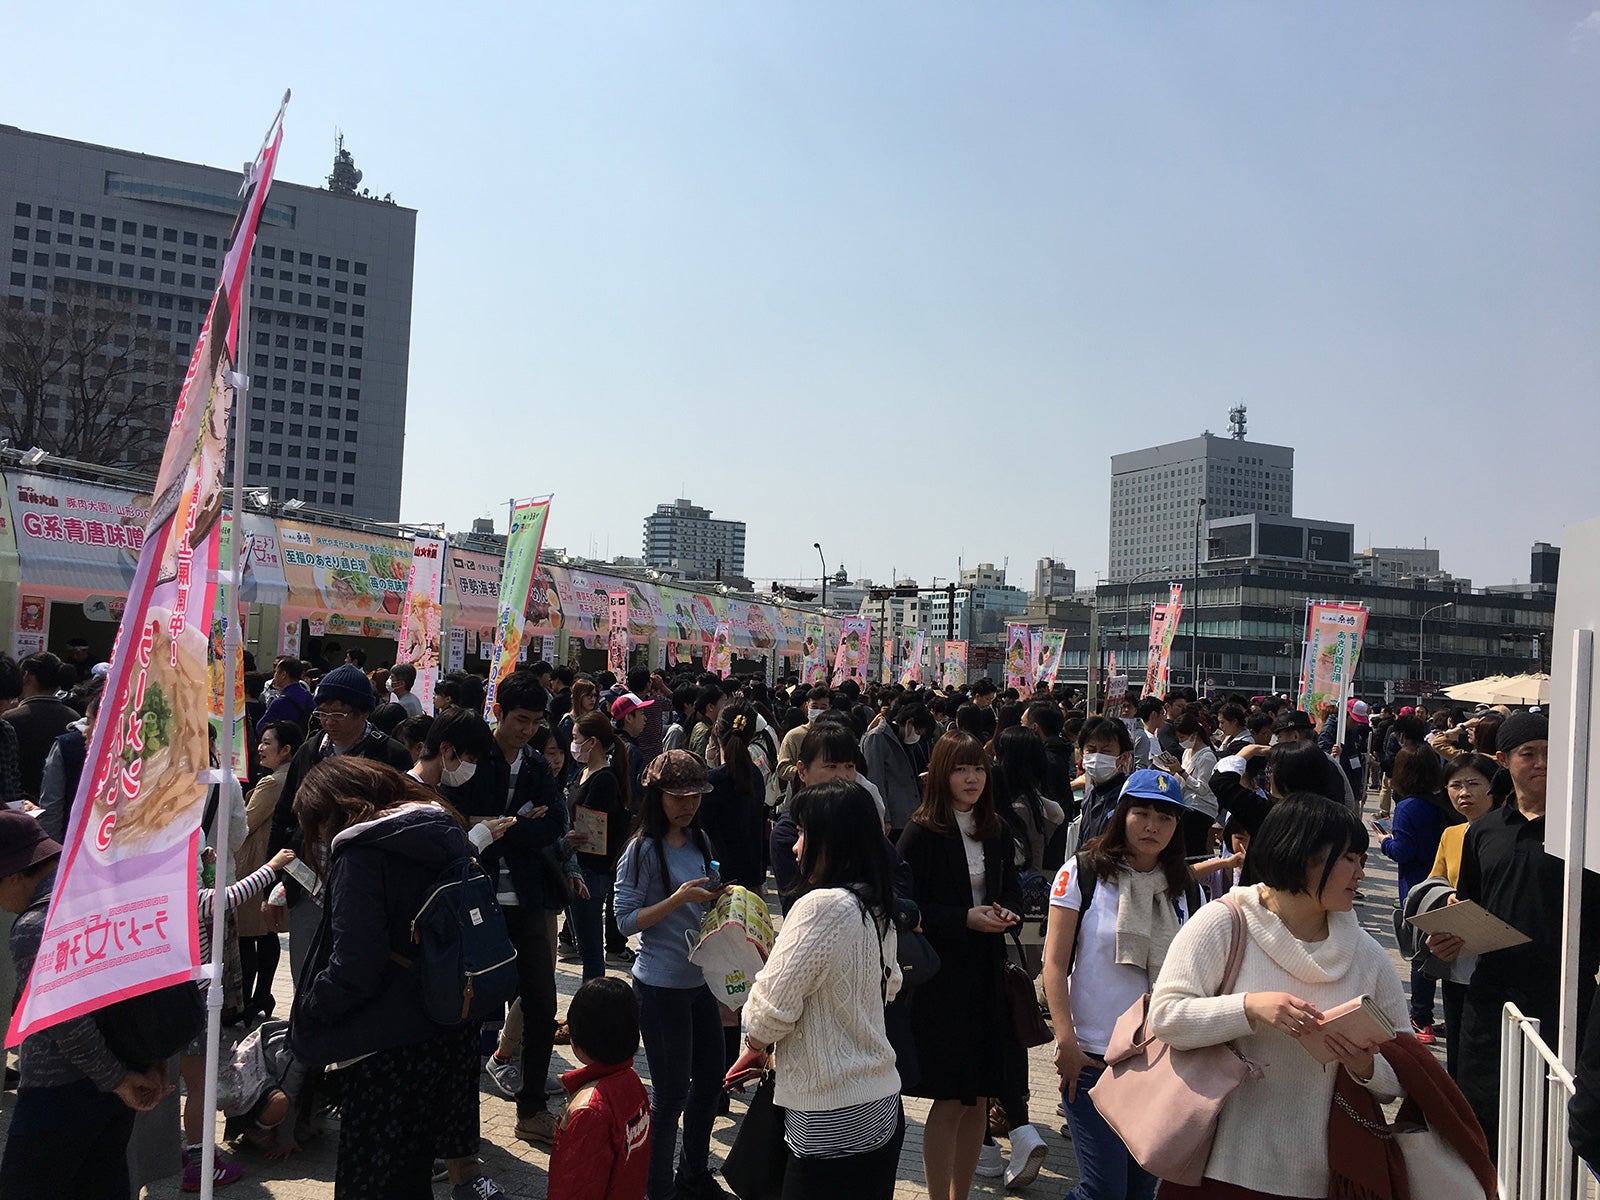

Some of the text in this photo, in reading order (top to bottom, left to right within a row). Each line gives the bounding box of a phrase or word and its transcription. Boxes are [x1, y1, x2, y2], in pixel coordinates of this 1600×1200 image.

[285, 549, 368, 573] 至福のあさり鶏白湯
[1053, 871, 1070, 897] 3
